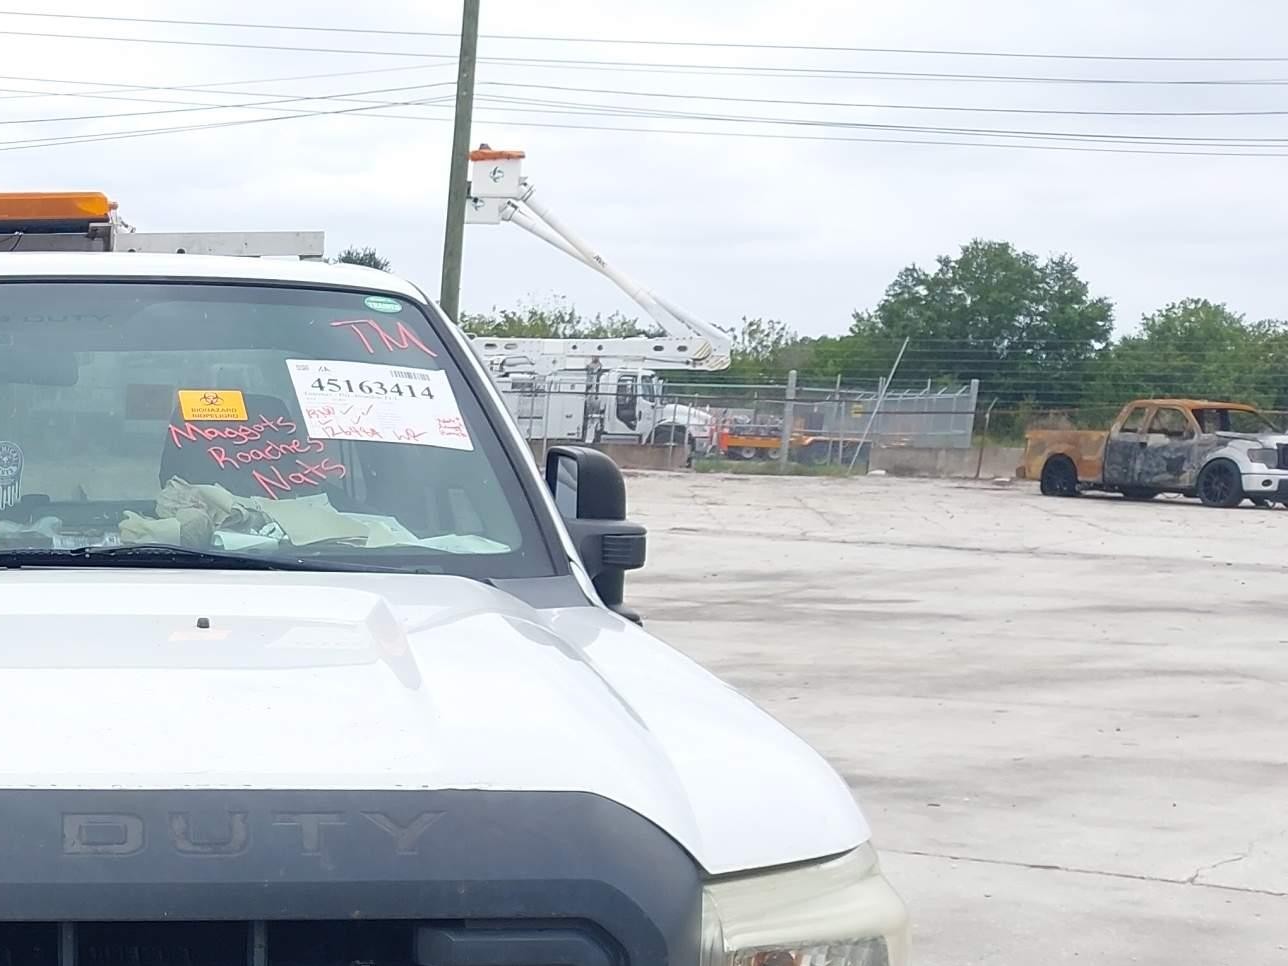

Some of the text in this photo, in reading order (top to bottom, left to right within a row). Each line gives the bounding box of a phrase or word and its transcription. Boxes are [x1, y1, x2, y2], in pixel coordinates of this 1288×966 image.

[329, 319, 438, 357] TM
[311, 377, 434, 400] 45163414
[168, 414, 297, 448] Maggots
[208, 435, 325, 470] Roaches
[252, 457, 347, 500] Nats
[60, 809, 448, 857] DUTY
